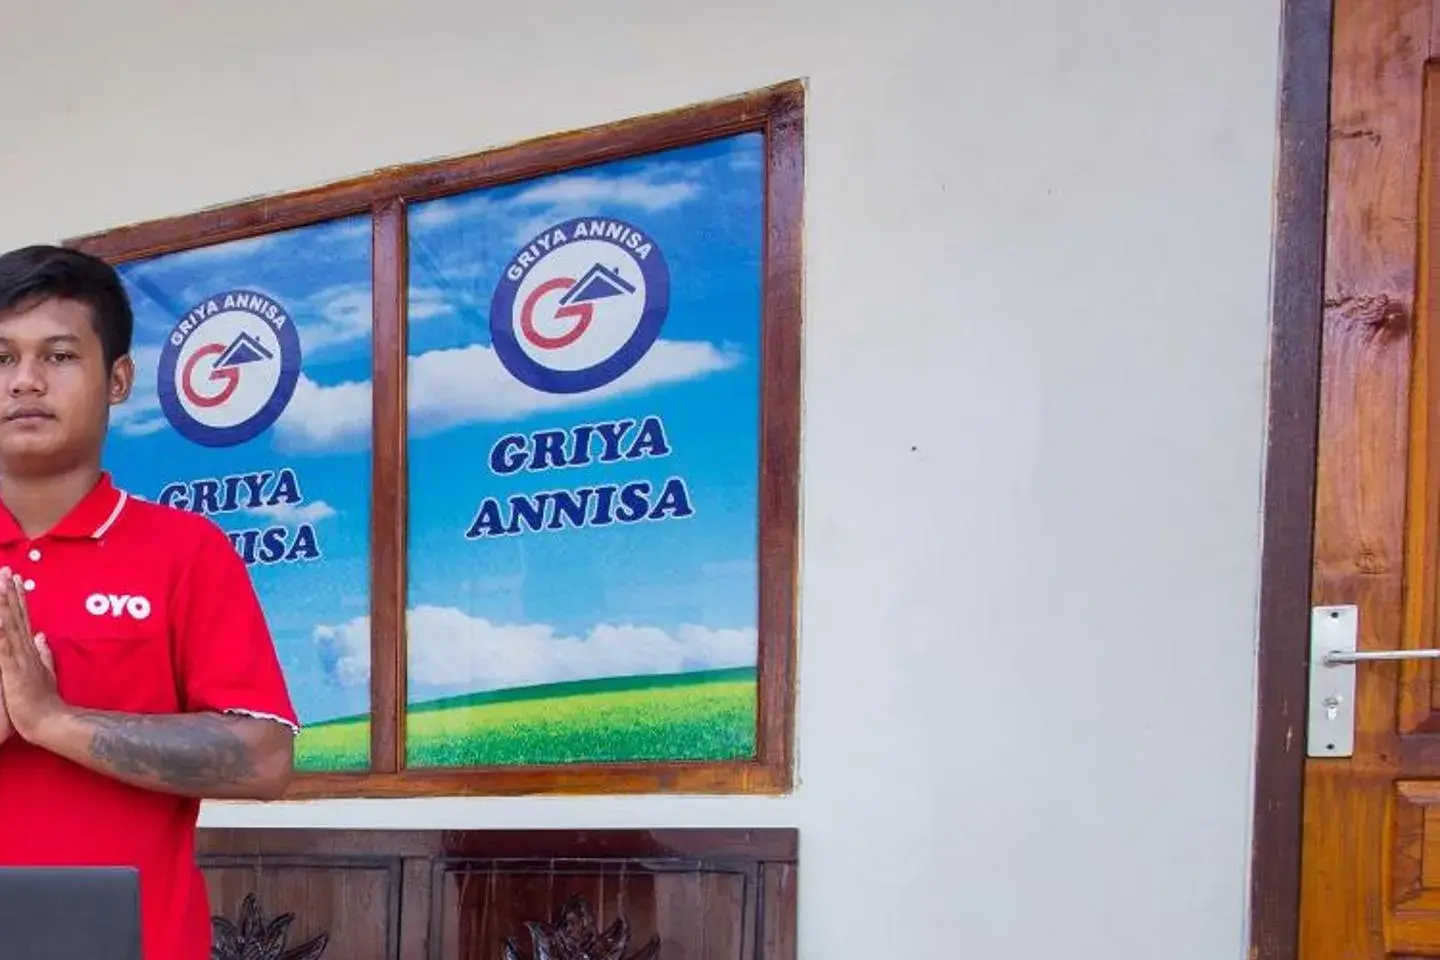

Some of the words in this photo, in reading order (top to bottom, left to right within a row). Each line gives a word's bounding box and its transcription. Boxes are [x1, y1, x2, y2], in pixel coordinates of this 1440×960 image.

[508, 228, 567, 281] GRIYA
[573, 220, 653, 261] ANNISA
[170, 300, 219, 347] GRIYA
[223, 293, 287, 331] ANNISA
[489, 415, 672, 476] GRIYA
[157, 468, 303, 515] GRIYA
[465, 476, 696, 541] ANNISA
[85, 592, 151, 620] OYO
